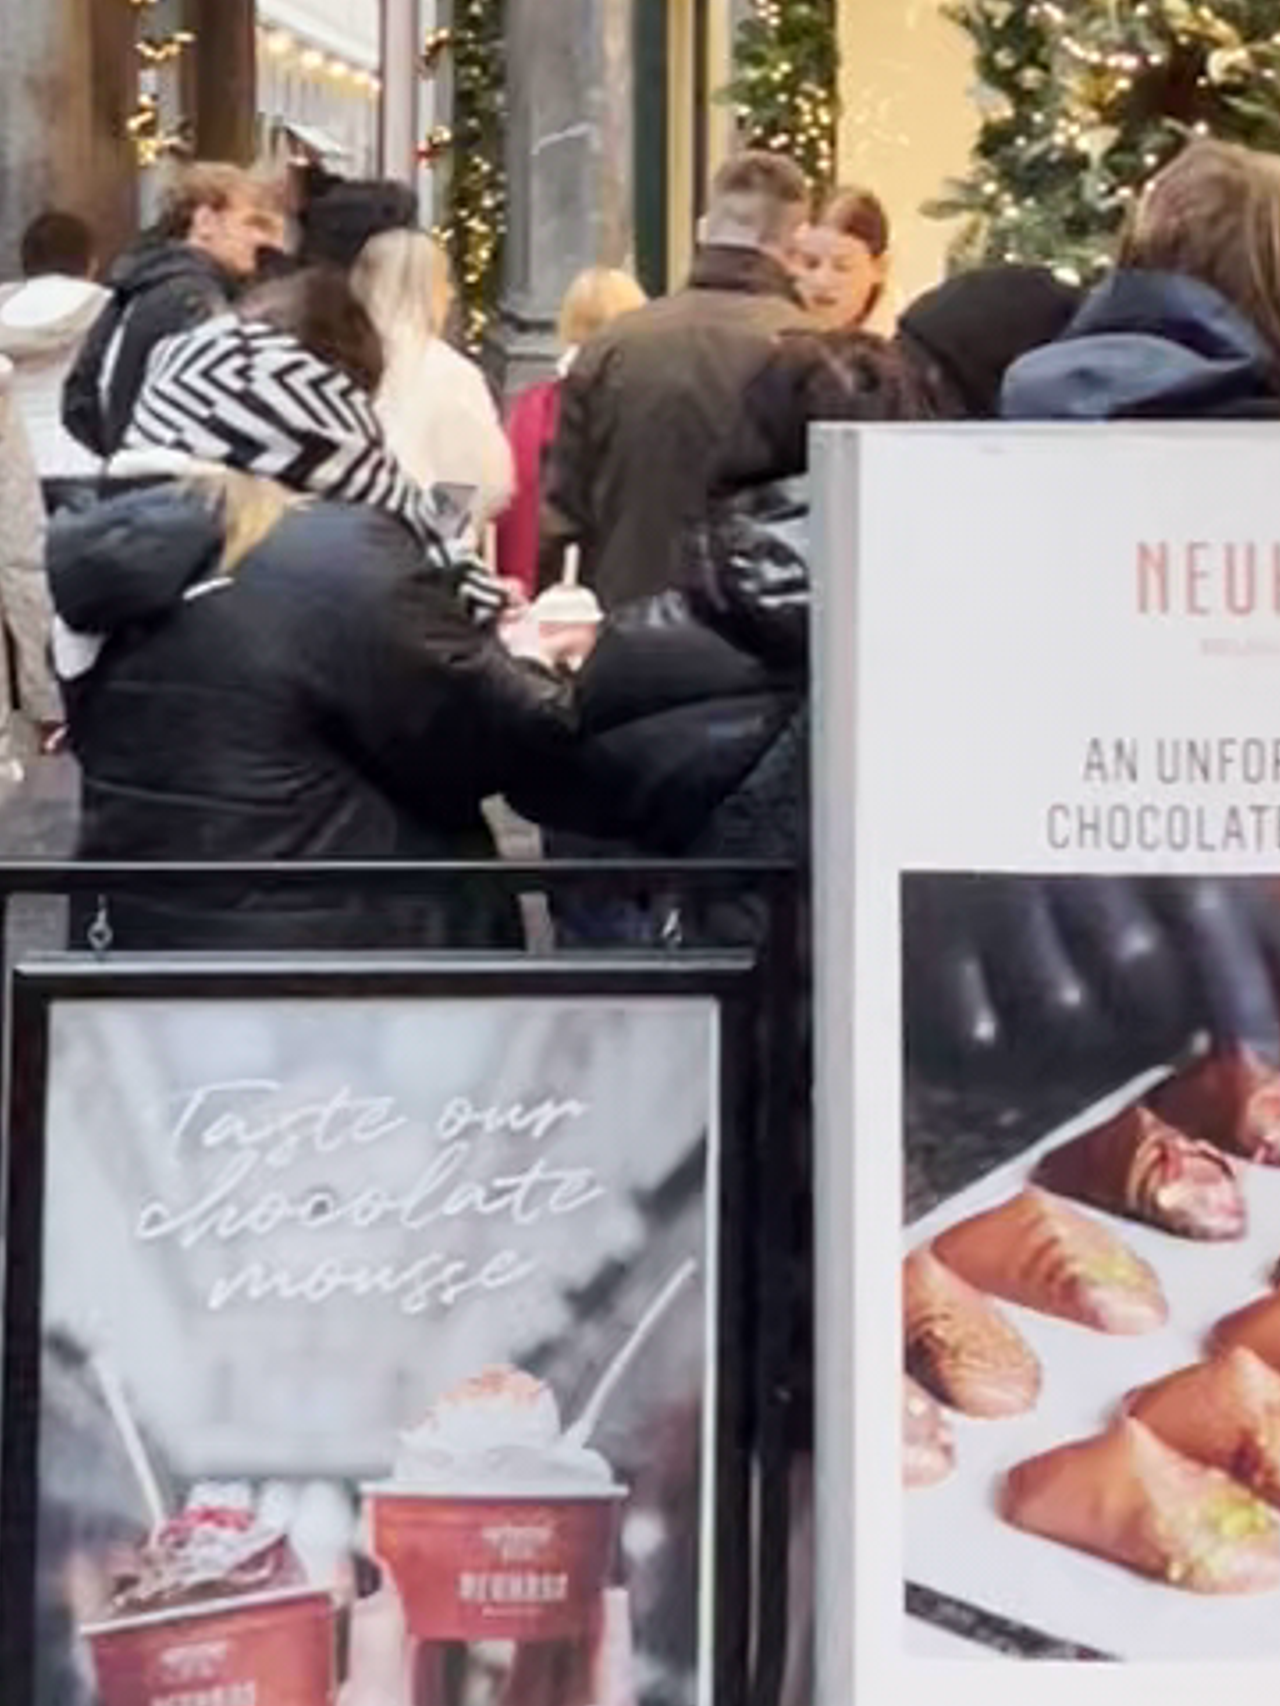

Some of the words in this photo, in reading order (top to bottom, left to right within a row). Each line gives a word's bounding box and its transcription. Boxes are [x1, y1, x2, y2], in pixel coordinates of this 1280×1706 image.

[1082, 736, 1138, 782] AN
[169, 1077, 408, 1166] Taste
[435, 1096, 589, 1139] our
[134, 1142, 606, 1249] chocolate
[207, 1249, 540, 1314] mousse
